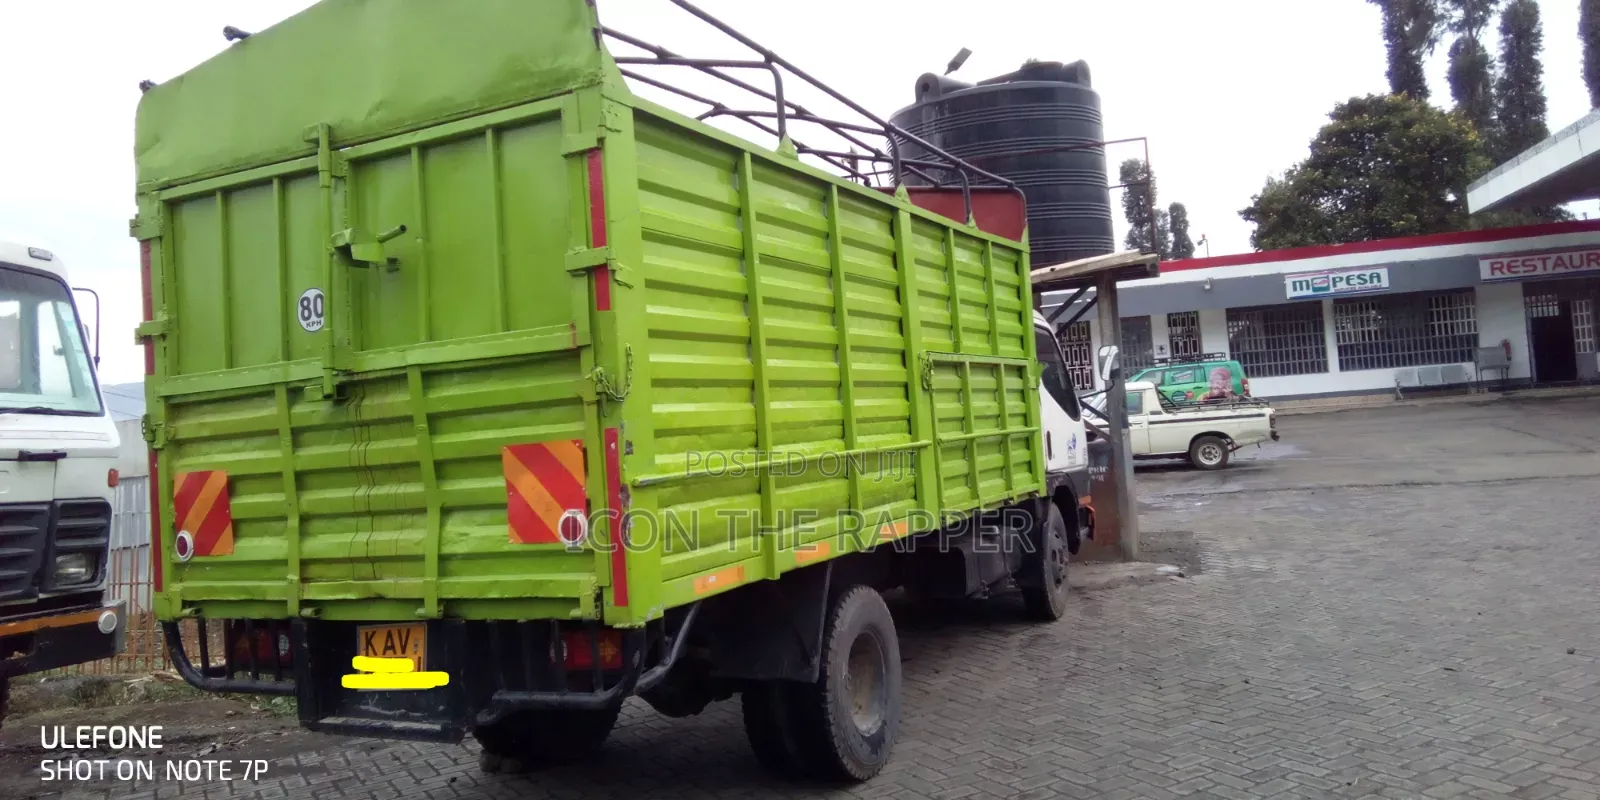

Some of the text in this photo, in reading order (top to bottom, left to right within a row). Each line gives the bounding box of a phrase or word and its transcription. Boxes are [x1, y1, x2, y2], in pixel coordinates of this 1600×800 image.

[300, 293, 324, 322] 80
[305, 319, 322, 328] KPH
[364, 627, 411, 657] KAV
